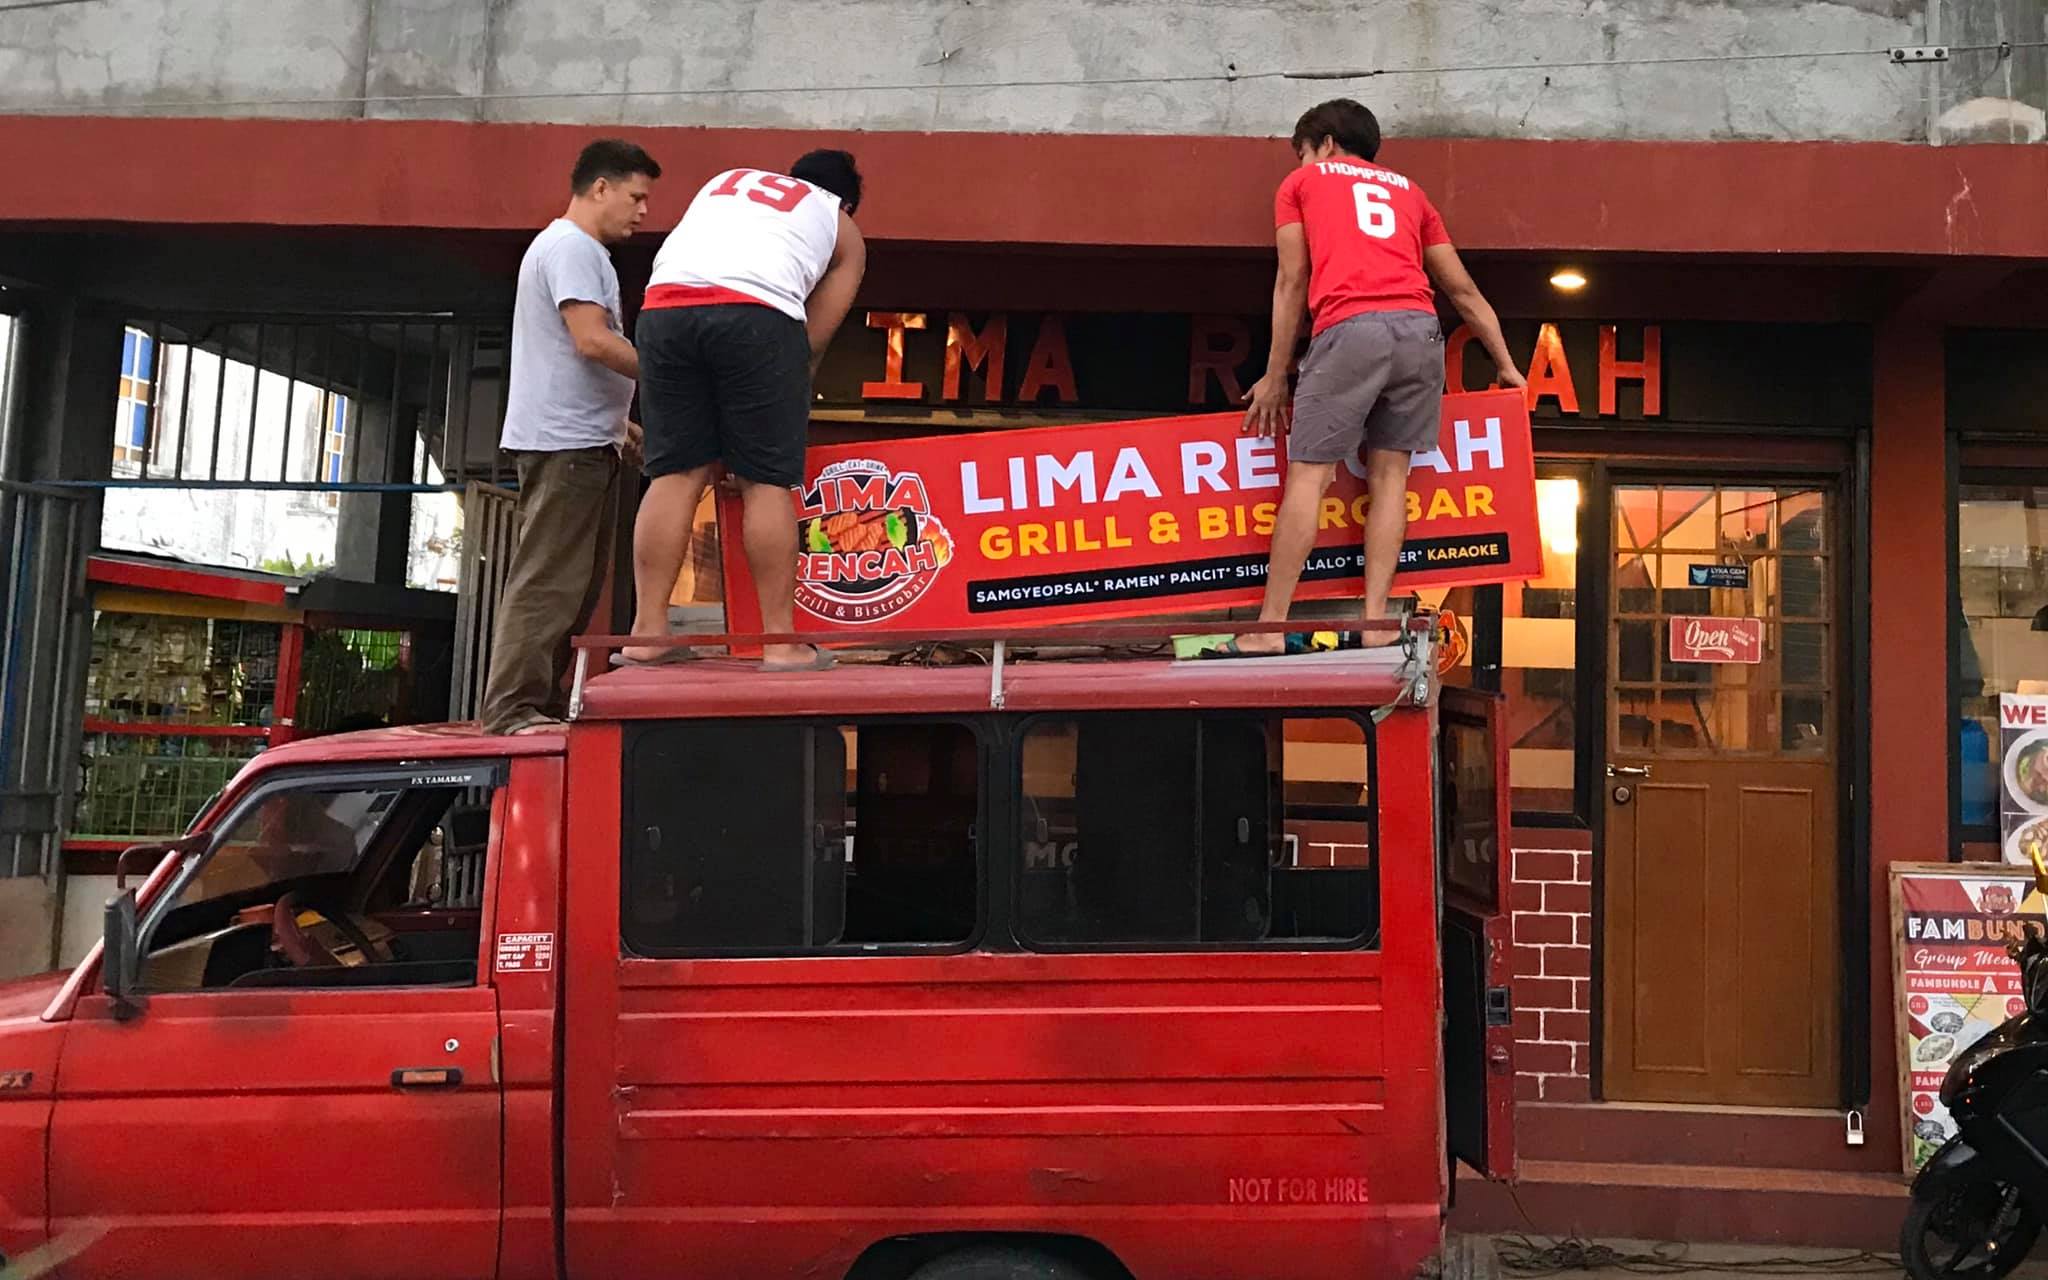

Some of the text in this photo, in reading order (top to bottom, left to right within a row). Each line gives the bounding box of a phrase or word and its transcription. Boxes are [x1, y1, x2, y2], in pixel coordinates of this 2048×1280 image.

[709, 170, 812, 212] 19
[1315, 162, 1410, 191] THOMPSON
[1352, 182, 1396, 239] 6
[861, 311, 1661, 416] IMA RCAH
[790, 475, 928, 521] LIMA
[961, 446, 1162, 515] LIMA
[979, 485, 1497, 560] GRILL & BISROBAR
[1427, 543, 1499, 561] KARAOKE
[794, 576, 926, 618] Grill & Bistrobar
[1685, 620, 1730, 657] Open
[2002, 704, 2047, 725] WE
[505, 935, 548, 943] CAPACITY
[1914, 949, 1968, 970] Group
[1911, 976, 1998, 993] FAMBUNDLE A
[1229, 1177, 1369, 1202] NOT FOR HIRE
